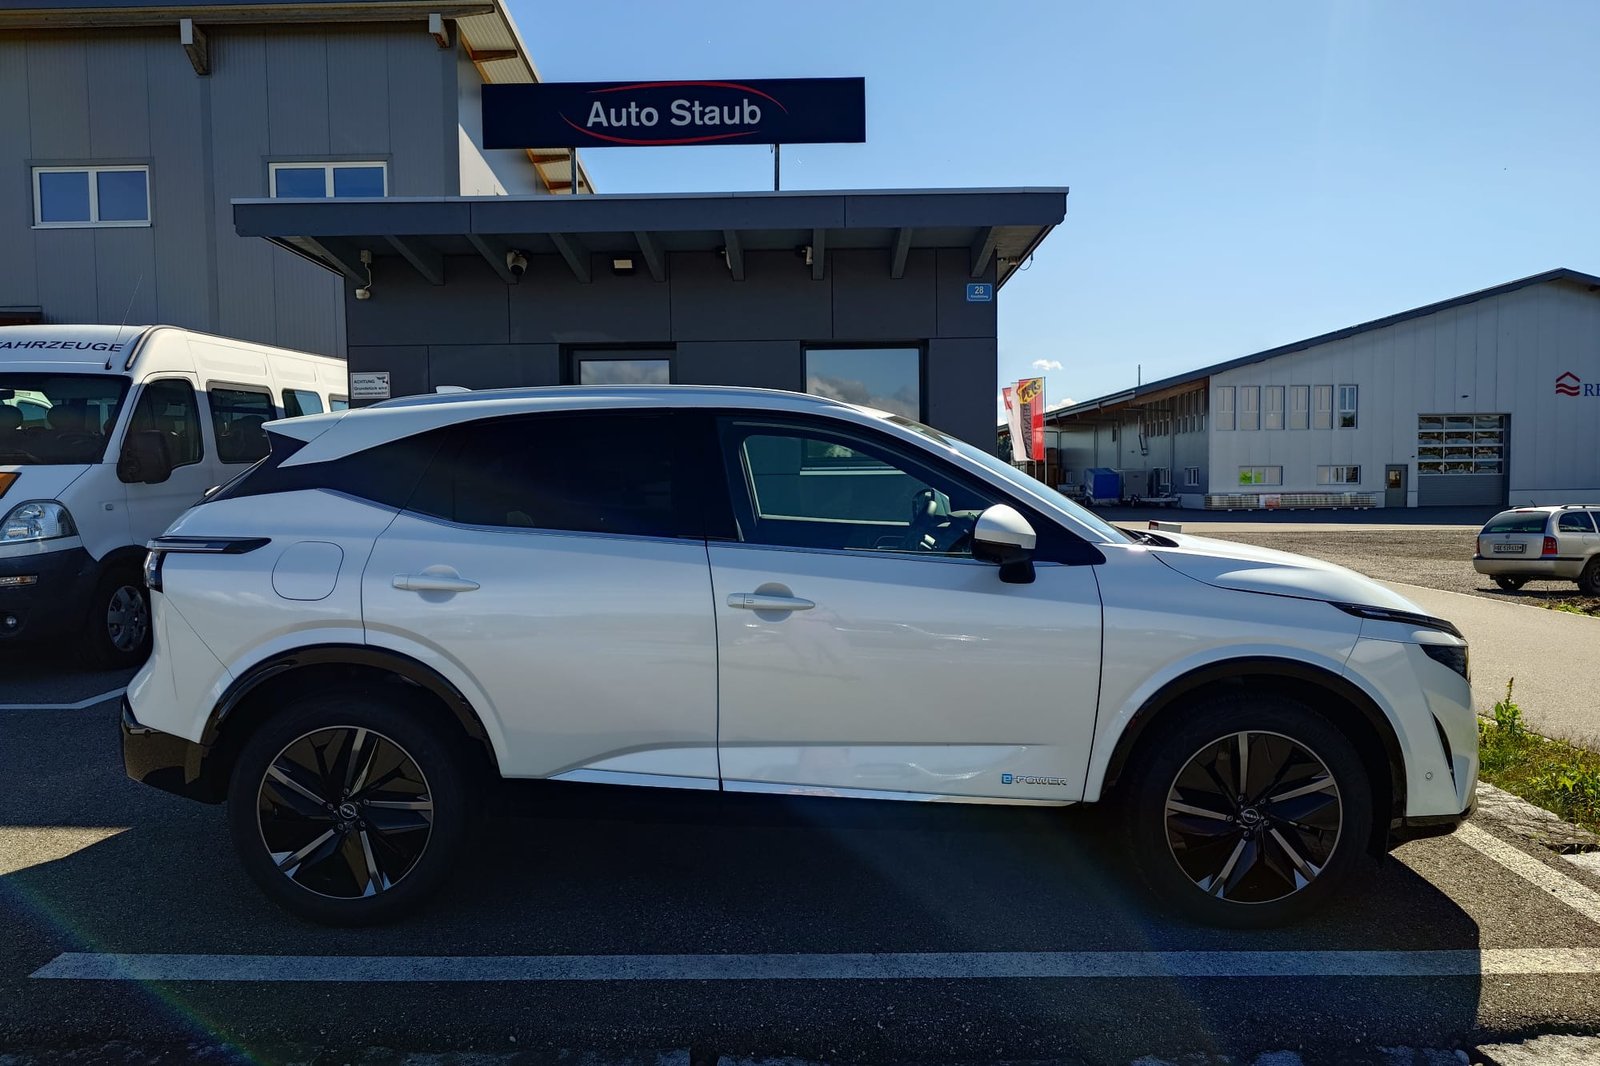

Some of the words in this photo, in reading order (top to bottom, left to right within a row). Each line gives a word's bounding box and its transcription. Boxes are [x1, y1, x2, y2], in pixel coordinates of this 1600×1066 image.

[587, 101, 659, 127] Auto
[670, 99, 761, 126] Staub
[974, 286, 984, 295] 28
[0, 341, 124, 352] AHRZEUGE
